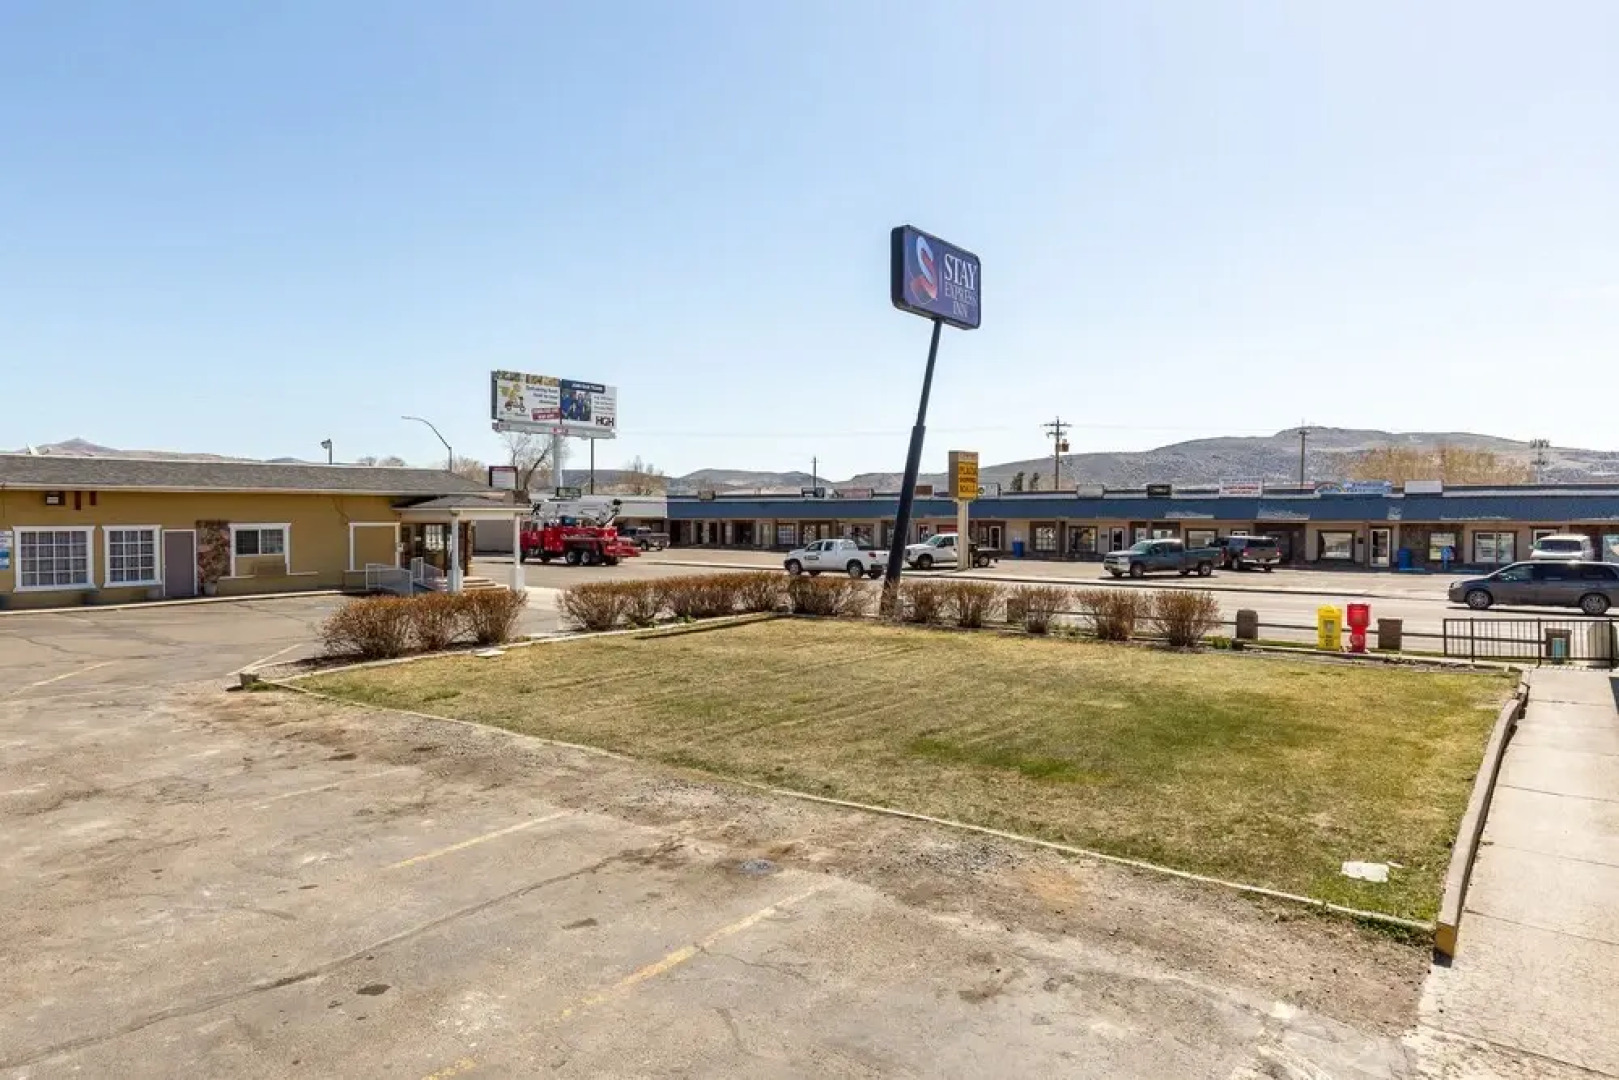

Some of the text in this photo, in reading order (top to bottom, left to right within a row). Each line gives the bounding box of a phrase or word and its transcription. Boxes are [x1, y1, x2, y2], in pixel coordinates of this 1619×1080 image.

[945, 253, 977, 290] STAY
[945, 281, 977, 306] EXPRESS
[953, 300, 968, 318] INN
[596, 416, 614, 427] HGH
